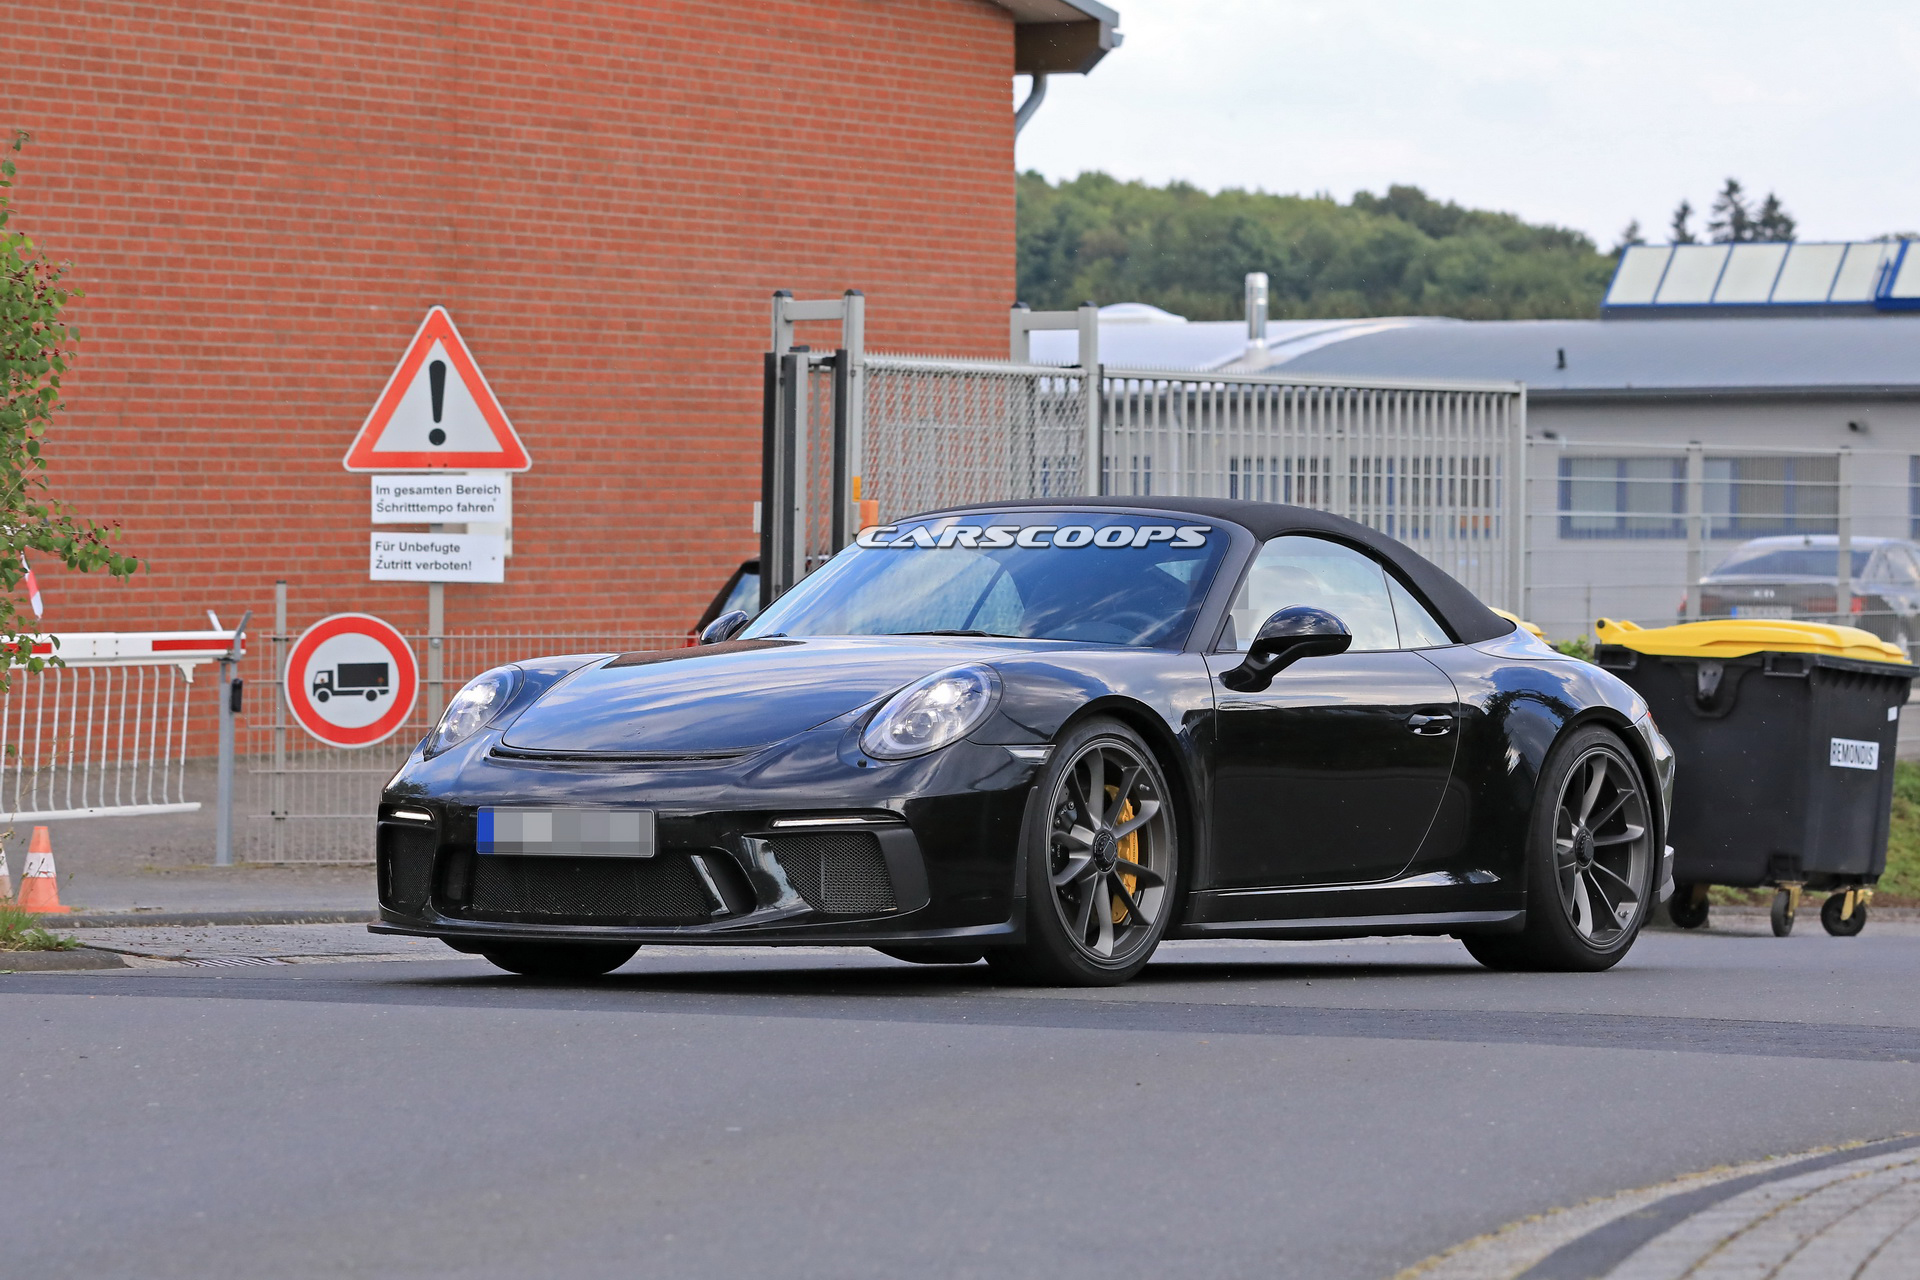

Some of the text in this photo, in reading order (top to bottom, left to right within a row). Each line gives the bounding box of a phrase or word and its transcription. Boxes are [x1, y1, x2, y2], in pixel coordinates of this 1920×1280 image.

[376, 485, 501, 497] Im gesamten Bereich
[376, 502, 494, 514] Schritttempo fahren
[375, 541, 461, 554] Für Unbefugte
[375, 560, 472, 571] Zutritt verboten!
[1831, 742, 1874, 765] REMONDIS
